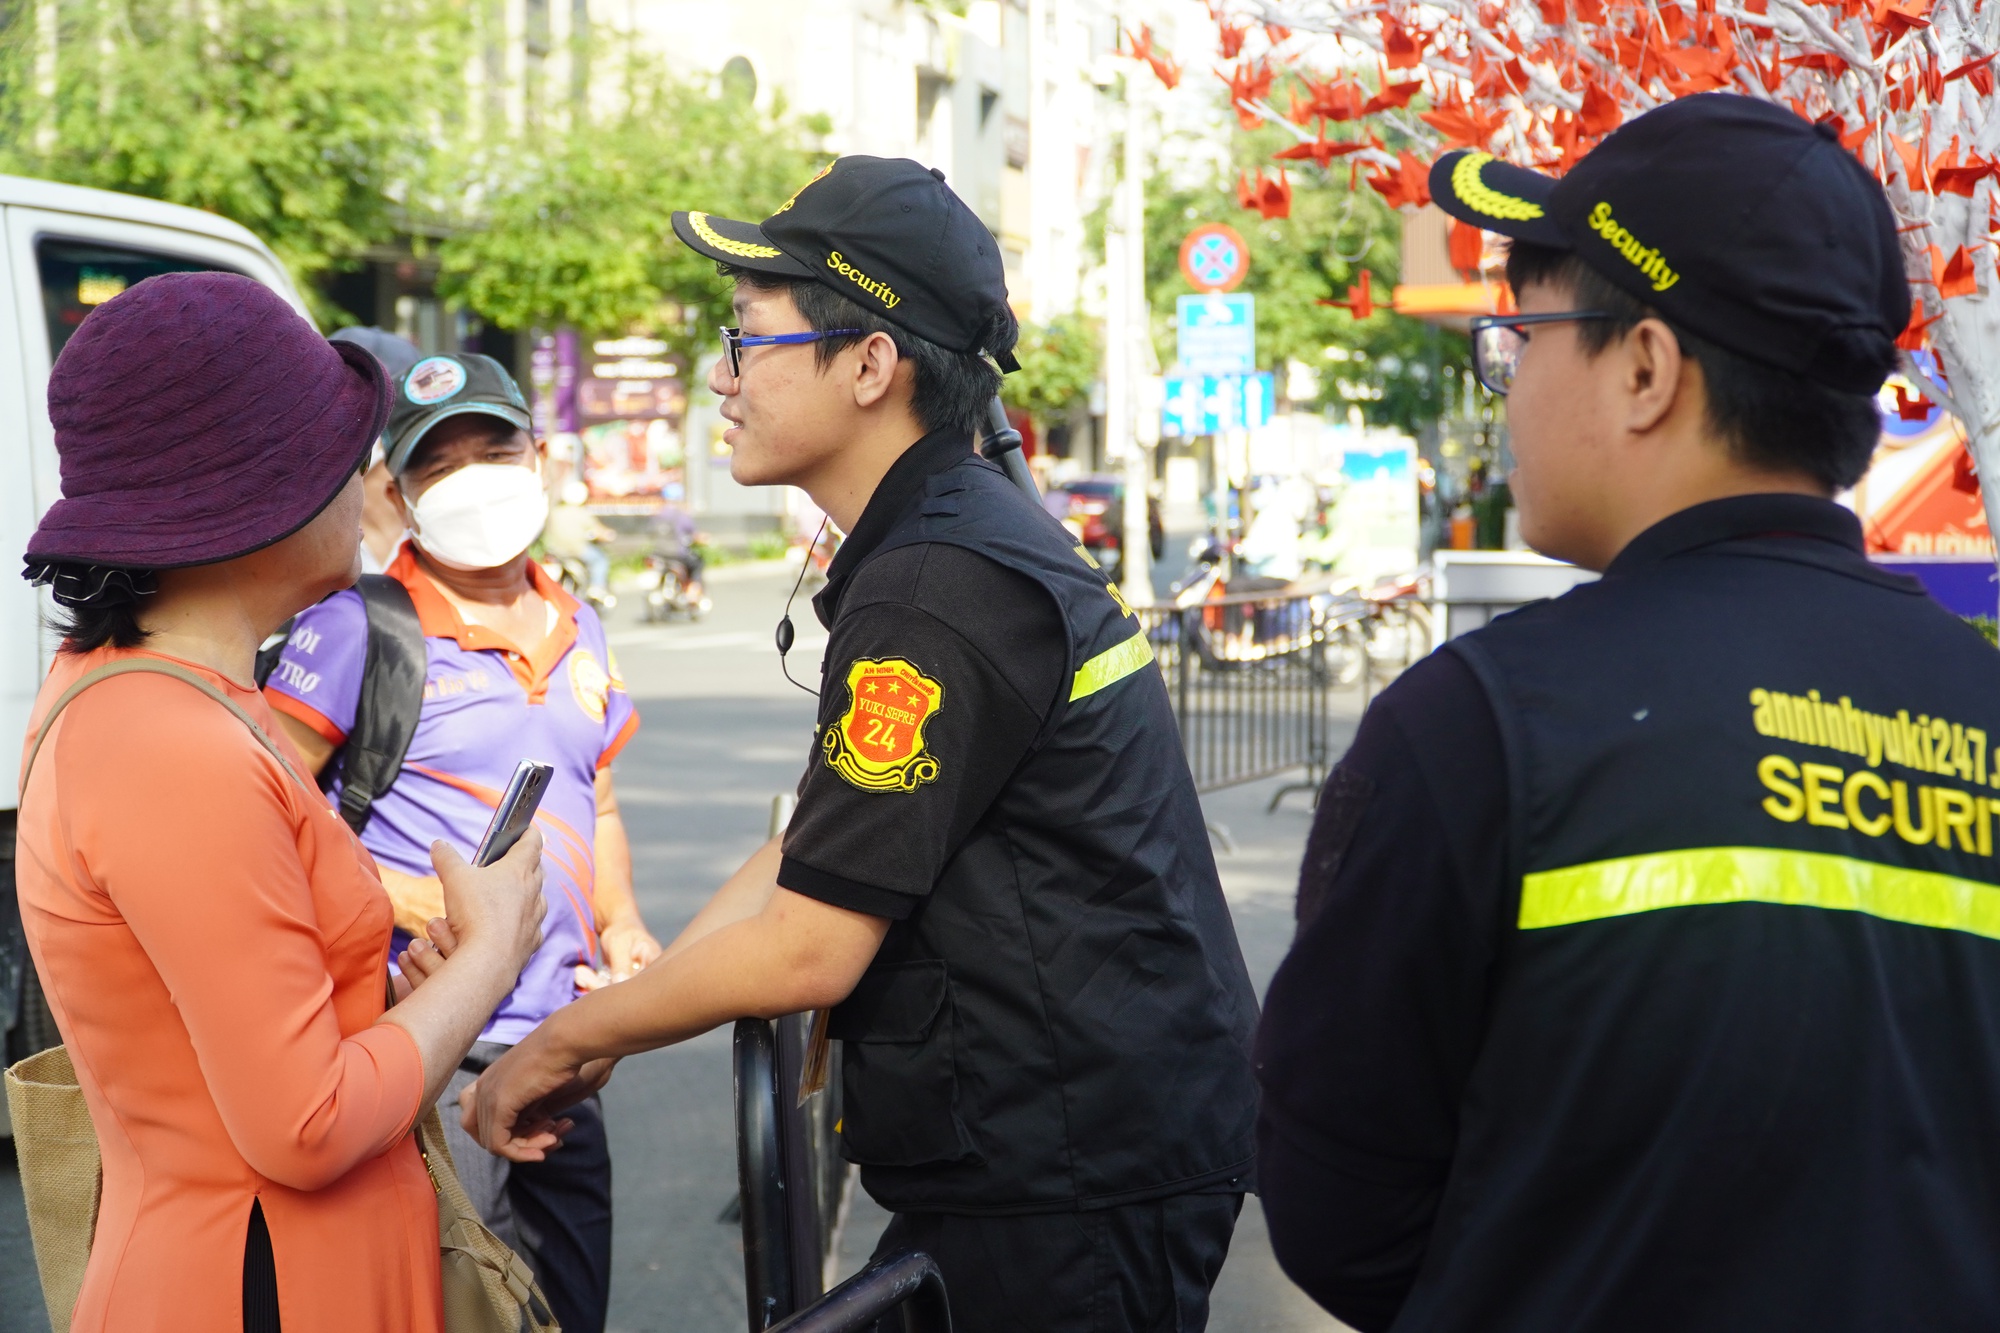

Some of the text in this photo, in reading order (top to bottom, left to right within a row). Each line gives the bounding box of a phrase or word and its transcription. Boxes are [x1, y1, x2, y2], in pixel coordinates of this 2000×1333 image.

[1588, 201, 1680, 291] Security
[826, 251, 901, 309] Security
[864, 667, 875, 675] AN
[876, 666, 895, 675] NINH
[859, 697, 917, 726] YUKI SEPRE
[863, 718, 896, 753] 24
